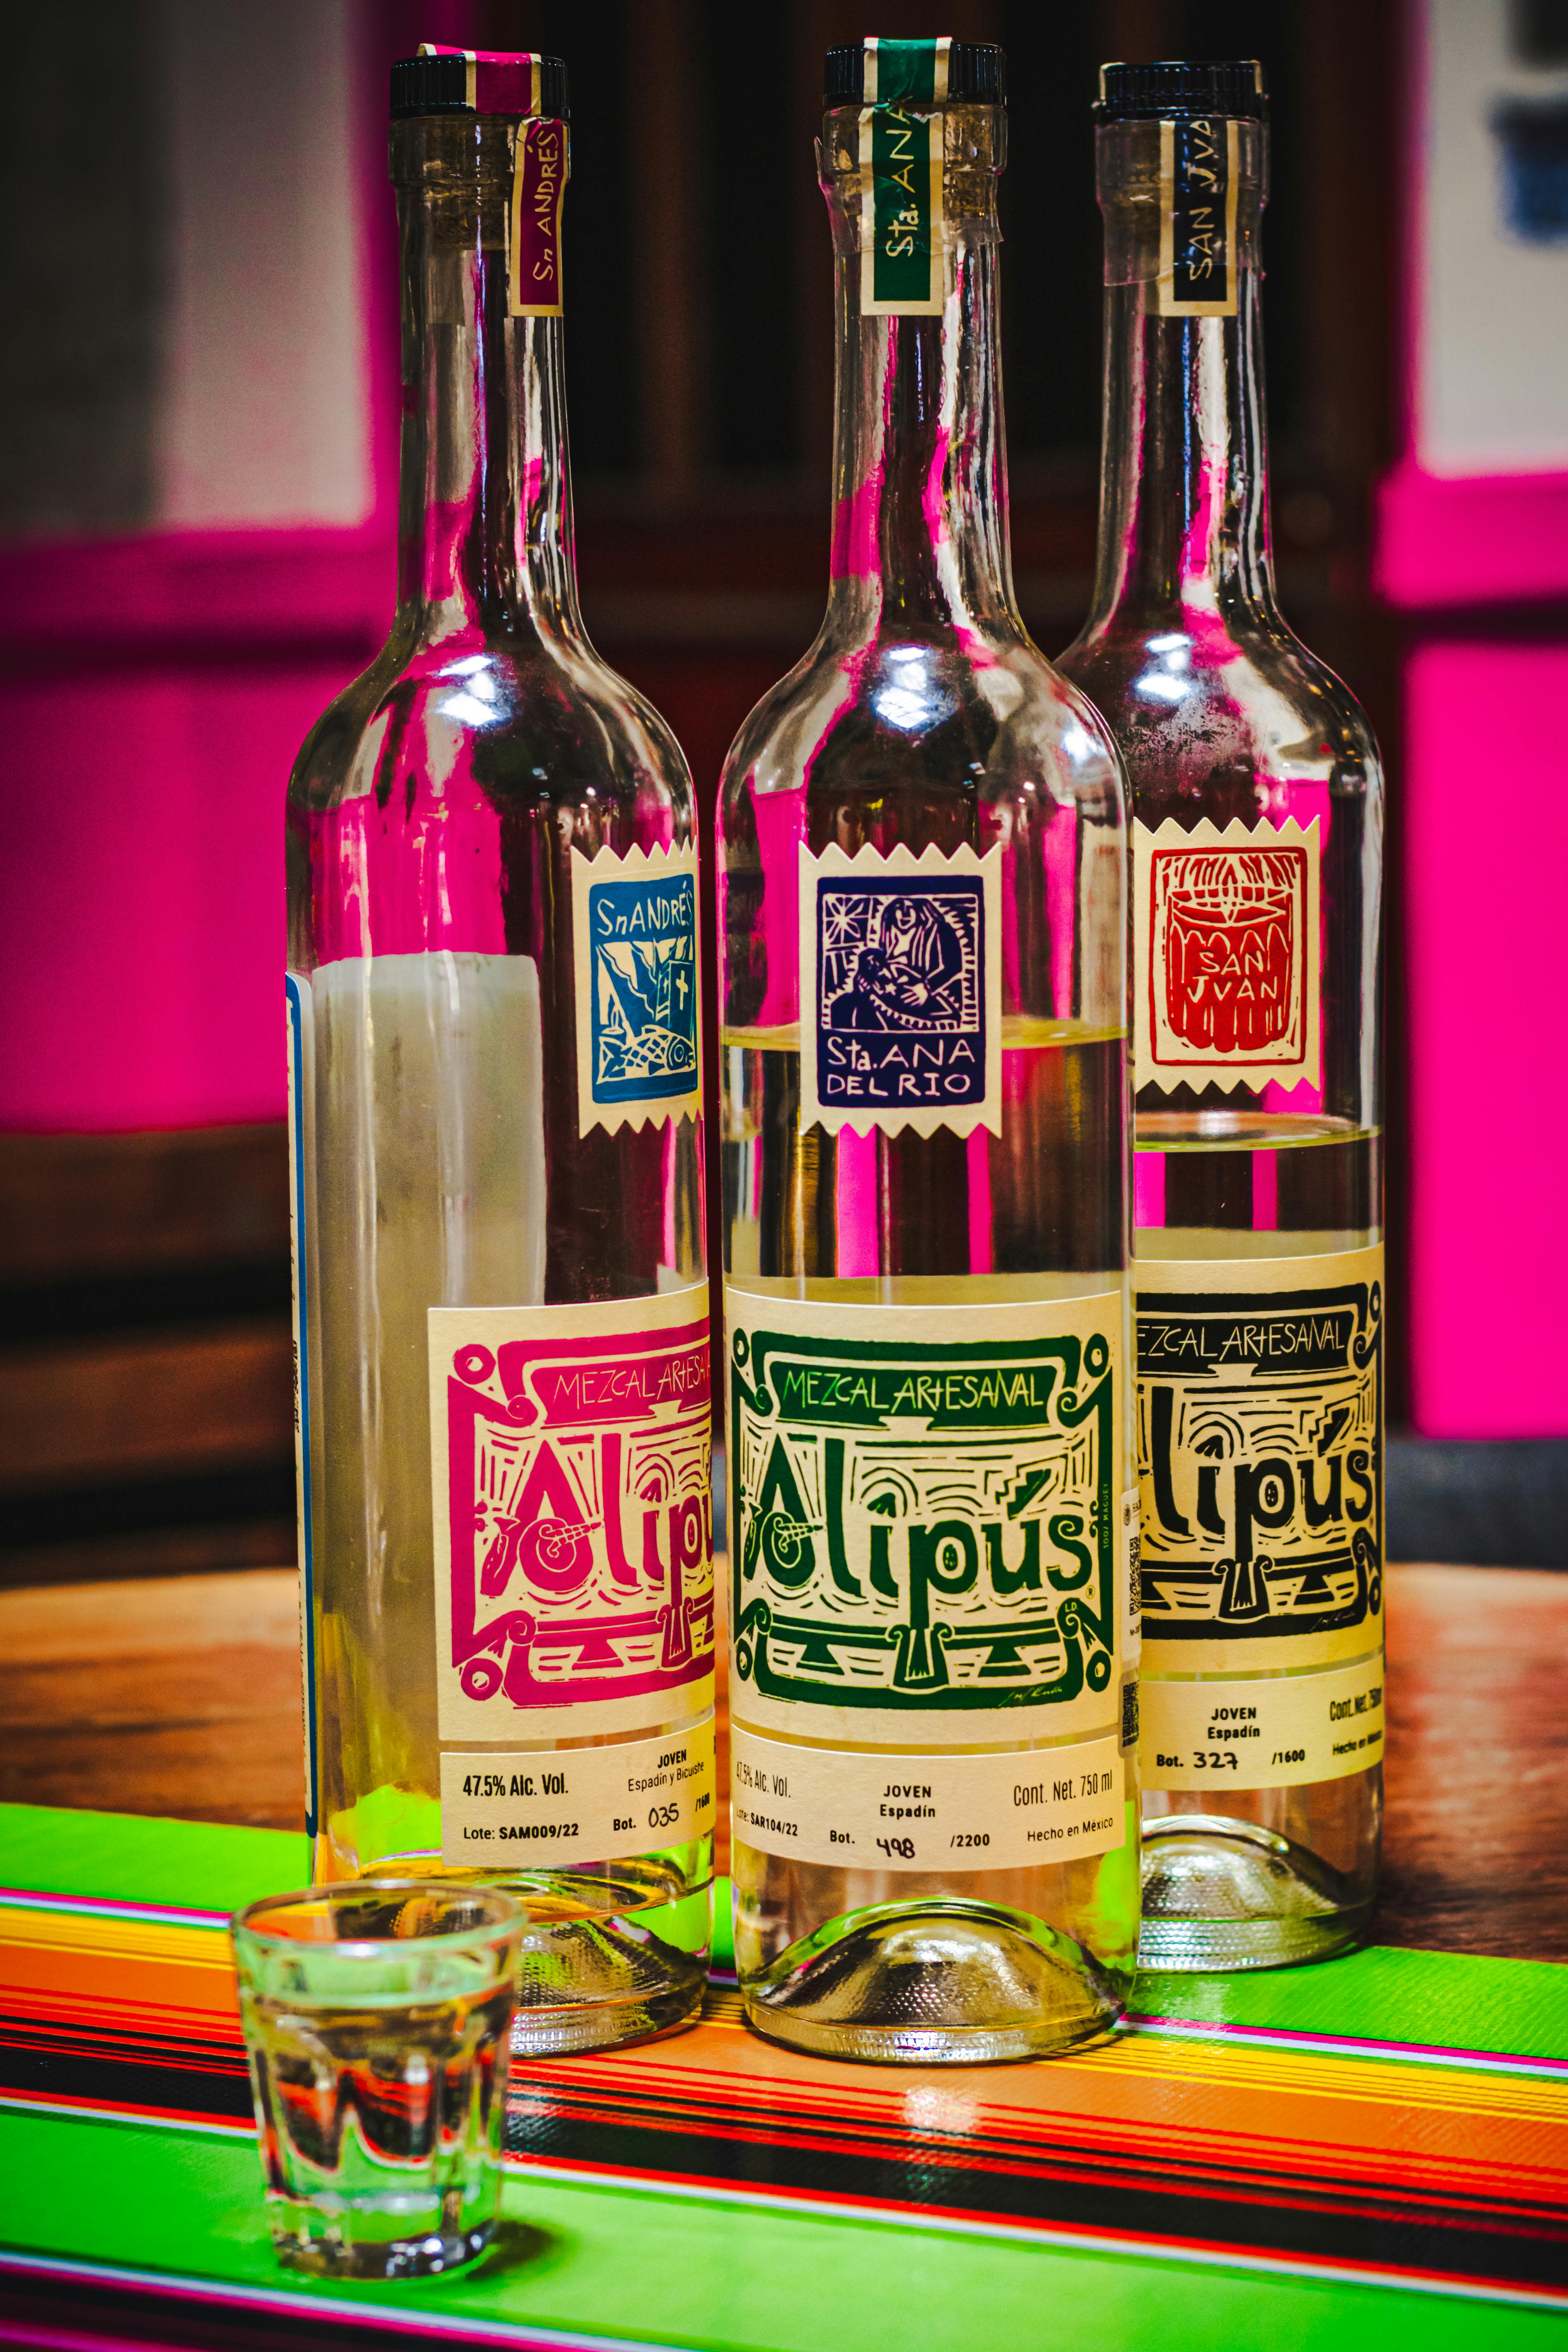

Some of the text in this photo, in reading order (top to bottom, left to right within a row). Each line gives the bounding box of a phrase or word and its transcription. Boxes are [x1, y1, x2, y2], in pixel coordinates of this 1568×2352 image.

[527, 131, 559, 281] Sn ANDRÉS
[886, 203, 919, 257] Sta.
[1189, 207, 1215, 280] SAN
[1199, 950, 1265, 975] SAN
[827, 1072, 970, 1096] DEL RIO
[1136, 1326, 1218, 1356] EZCAL
[553, 1365, 655, 1409] MEZCAL
[783, 1370, 890, 1409] MEZCAL
[743, 1433, 1092, 1628] Alipús
[1211, 1707, 1256, 1721] JOVEN
[1208, 1726, 1260, 1741] Espadín
[658, 1749, 686, 1768] JOVEN
[1157, 1749, 1305, 1770] Bot. 327 /1600
[463, 1773, 569, 1796] 47.5% Alc. Vol.
[628, 1761, 704, 1792] Espadín y Bicuishe
[755, 1769, 769, 1793] Alc.
[773, 1774, 791, 1798] Vol.
[1014, 1769, 1112, 1806] Cont. Net. 750 ml
[884, 1785, 931, 1798] JOVEN
[613, 1817, 636, 1831] Bot.
[648, 1802, 679, 1828] 035
[751, 1812, 798, 1837] SAR104/22
[880, 1804, 935, 1820] Espadín
[464, 1823, 579, 1840] Lote: SAM009/22
[1028, 1816, 1113, 1841] Hecho en México
[830, 1830, 990, 1859] Bot. 498 /2200
